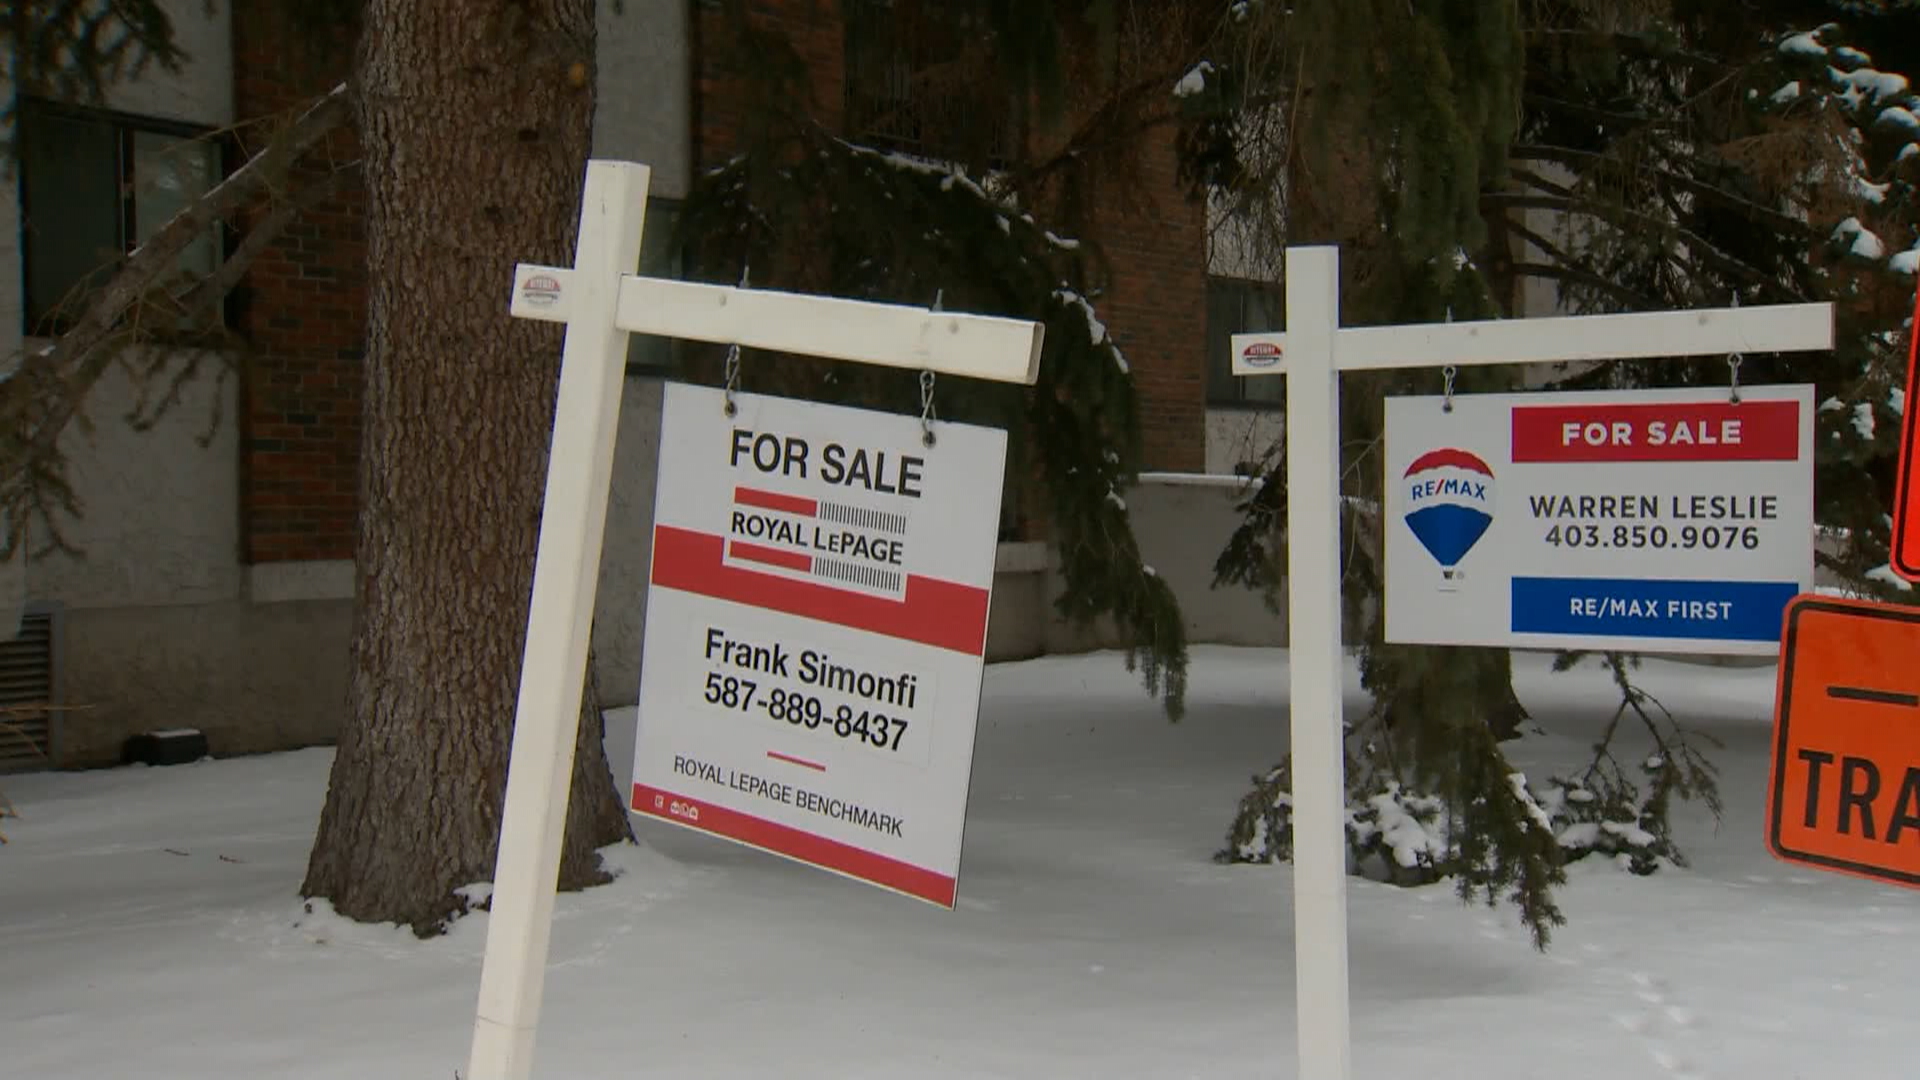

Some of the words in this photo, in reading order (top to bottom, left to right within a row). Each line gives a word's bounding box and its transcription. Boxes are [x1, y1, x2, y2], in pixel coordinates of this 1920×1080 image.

[1561, 422, 1632, 446] FOR
[1646, 420, 1742, 444] SALE
[731, 429, 808, 478] FOR
[820, 444, 924, 498] SALE
[1412, 478, 1486, 501] RE/MAX
[1529, 495, 1658, 518] WARREN
[1672, 495, 1778, 519] LESLIE
[731, 511, 808, 548] ROYAL
[1545, 525, 1760, 550] 403.850.9076
[1570, 598, 1659, 618] RE/MAX
[1667, 601, 1733, 620] FIRST
[705, 628, 790, 677] Frank
[798, 650, 917, 709] Simonfi
[704, 672, 909, 752] 587-889-8437
[673, 755, 726, 787] ROYAL
[729, 773, 792, 805] LEPAGE
[796, 791, 904, 838] BENCHMARK
